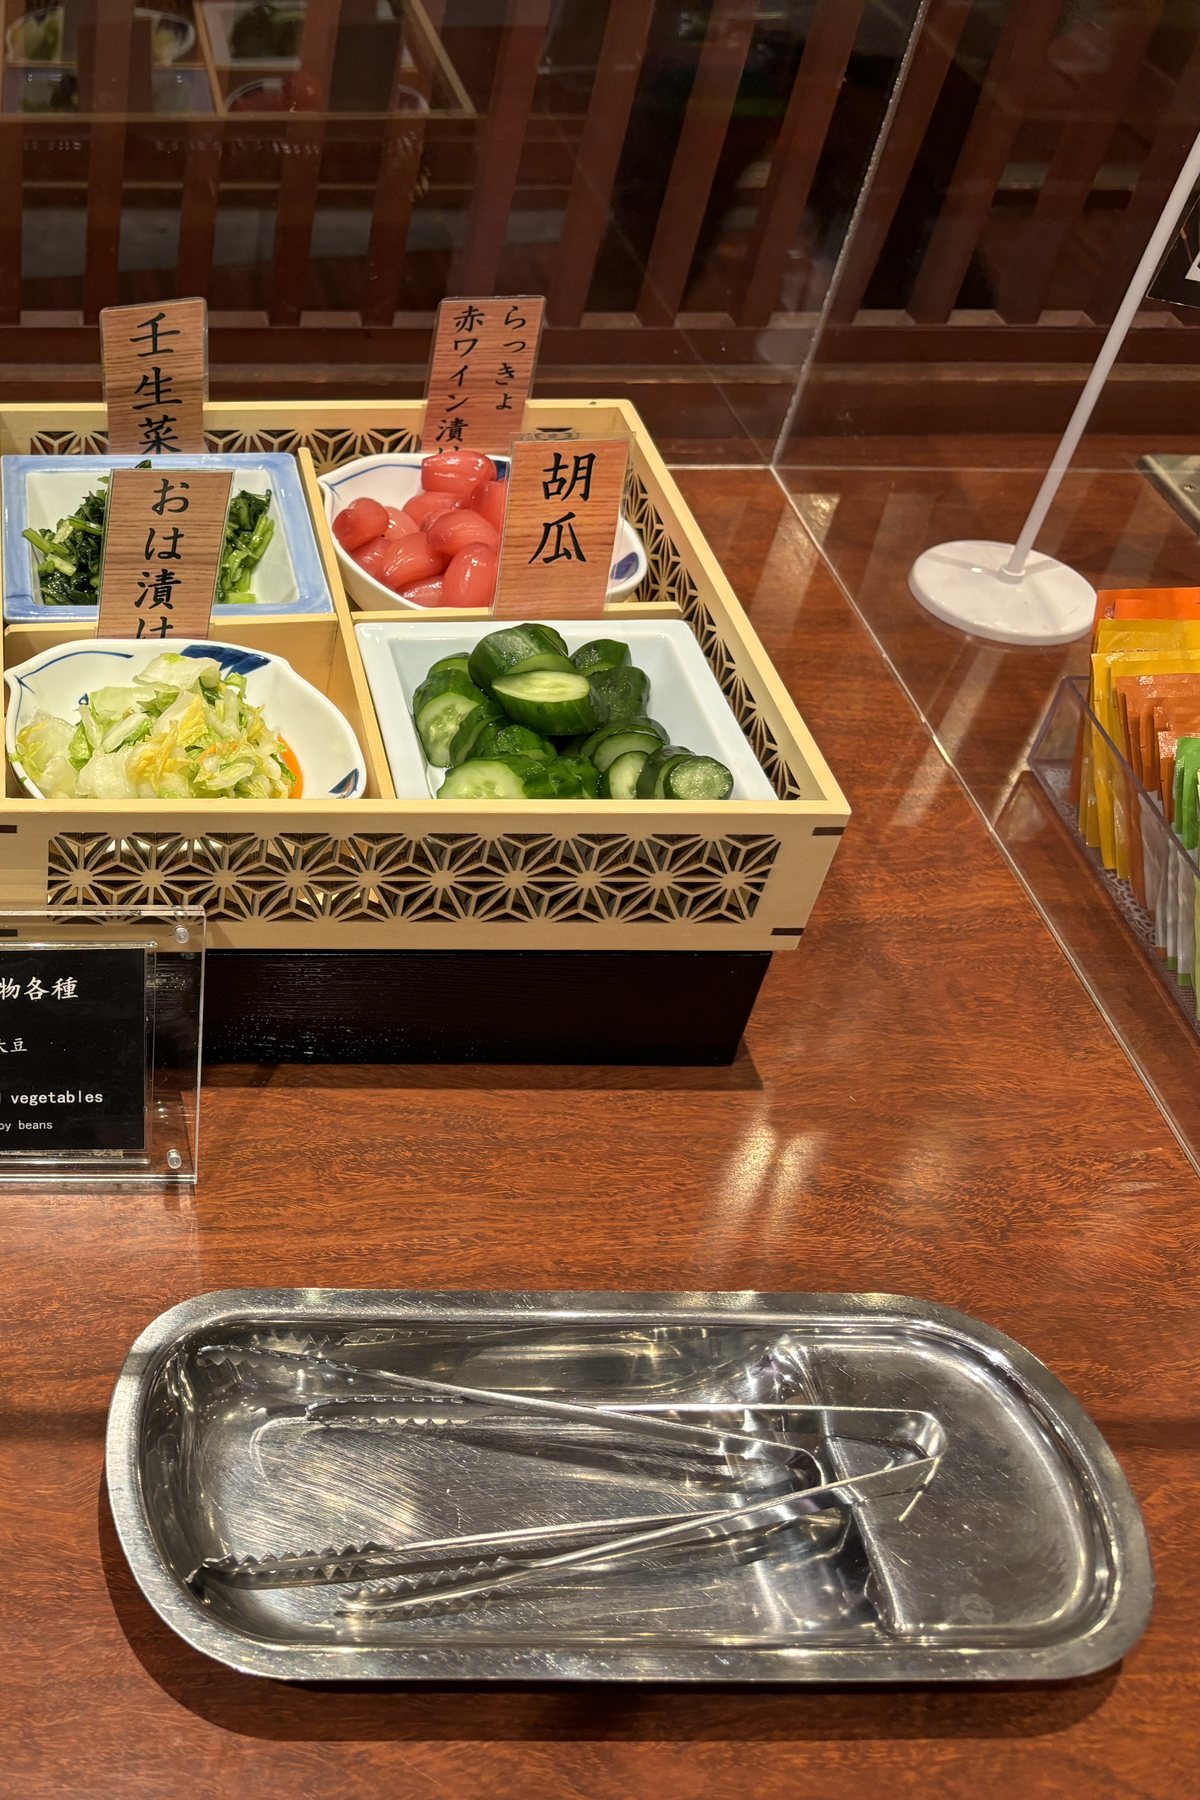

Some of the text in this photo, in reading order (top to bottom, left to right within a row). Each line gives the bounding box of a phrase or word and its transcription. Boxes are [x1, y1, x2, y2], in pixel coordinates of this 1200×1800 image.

[129, 312, 183, 455] 壬生菜
[435, 305, 485, 455] 赤ワイン漬
[495, 305, 527, 411] らっきょ
[528, 451, 597, 565] 胡瓜
[10, 1090, 104, 1107] vegetables
[18, 1119, 54, 1131] beans
